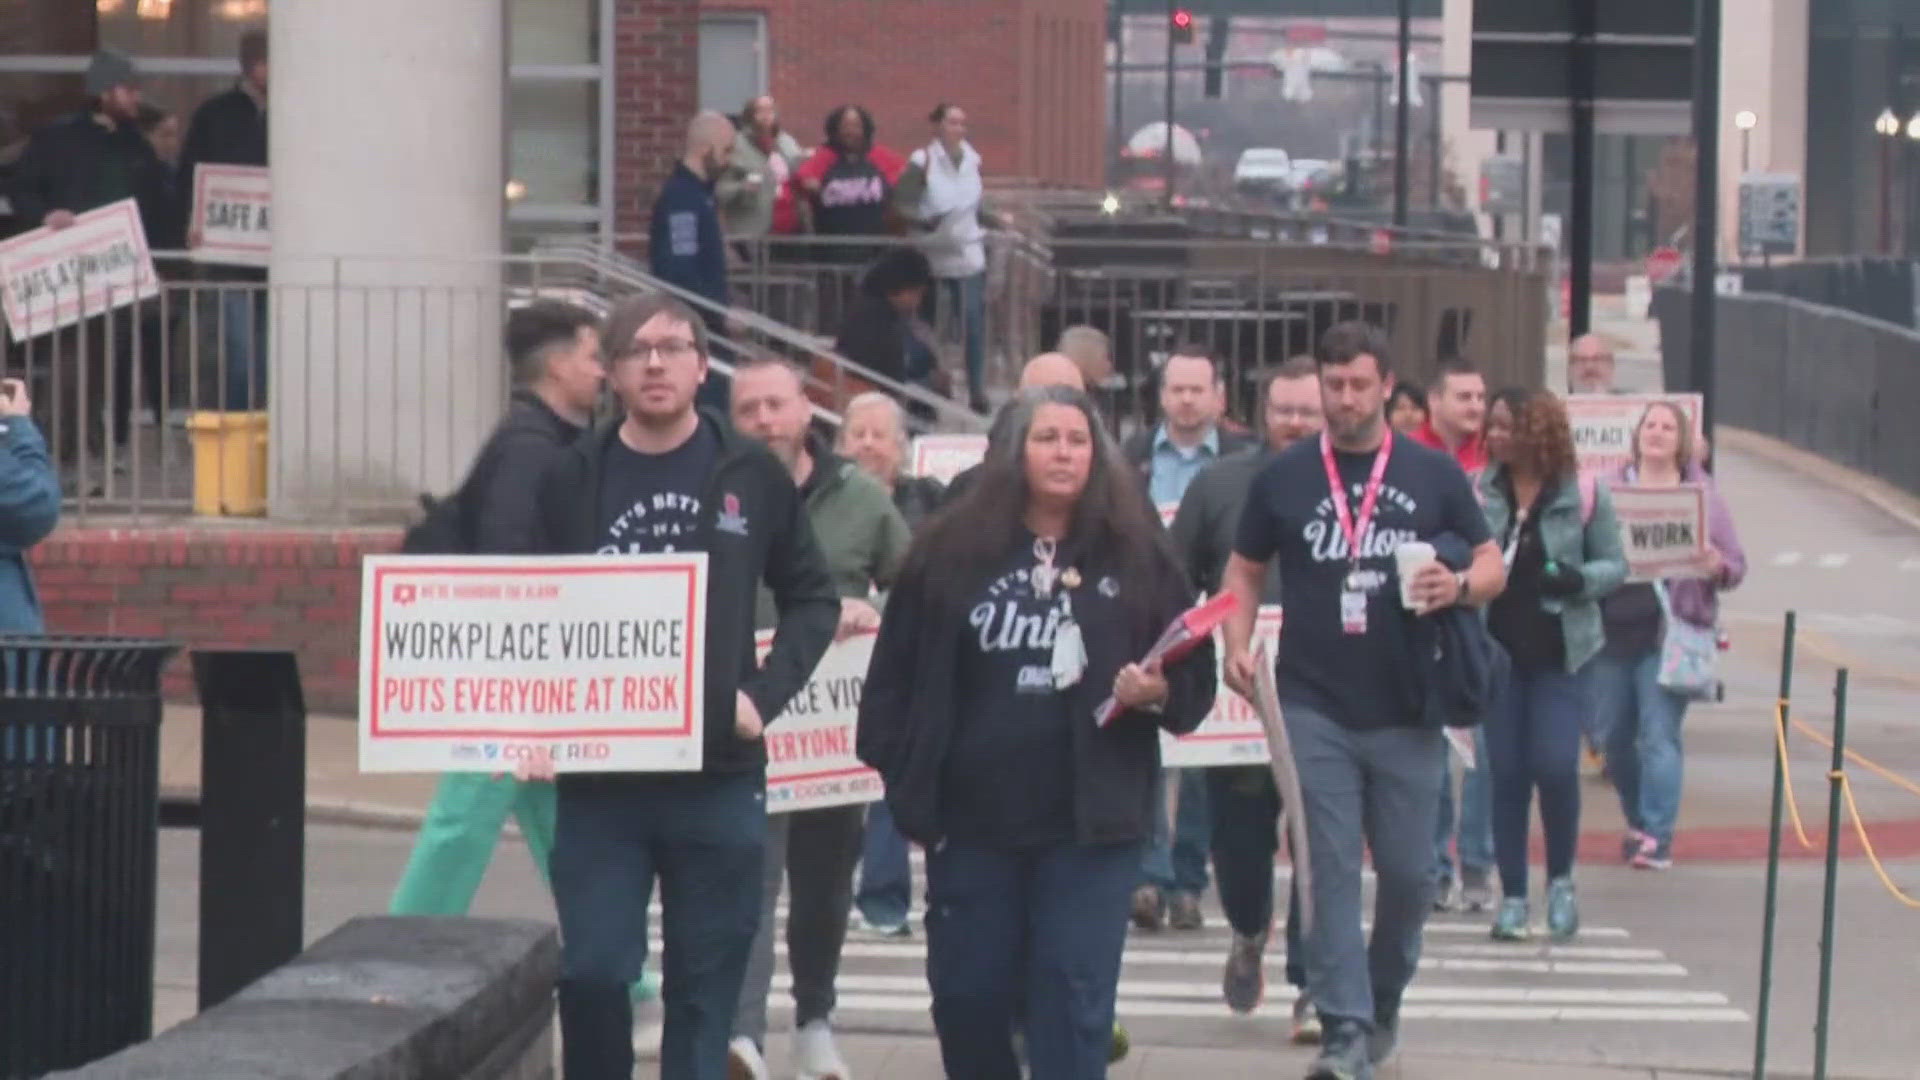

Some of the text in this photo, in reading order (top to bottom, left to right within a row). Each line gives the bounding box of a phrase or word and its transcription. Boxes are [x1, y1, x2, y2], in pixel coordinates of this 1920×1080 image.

[206, 203, 252, 230] SAFE
[1353, 482, 1417, 514] BTTER
[609, 501, 647, 539] IT'S
[1629, 522, 1693, 549] WORK
[1303, 518, 1417, 562] Uio
[988, 568, 1029, 597] IT'S
[385, 619, 683, 661] WORKPLACE VIOLENCE
[383, 673, 679, 714] PUTS EVERYONE AT RISK
[503, 743, 559, 761] COE
[566, 742, 611, 760] RED
